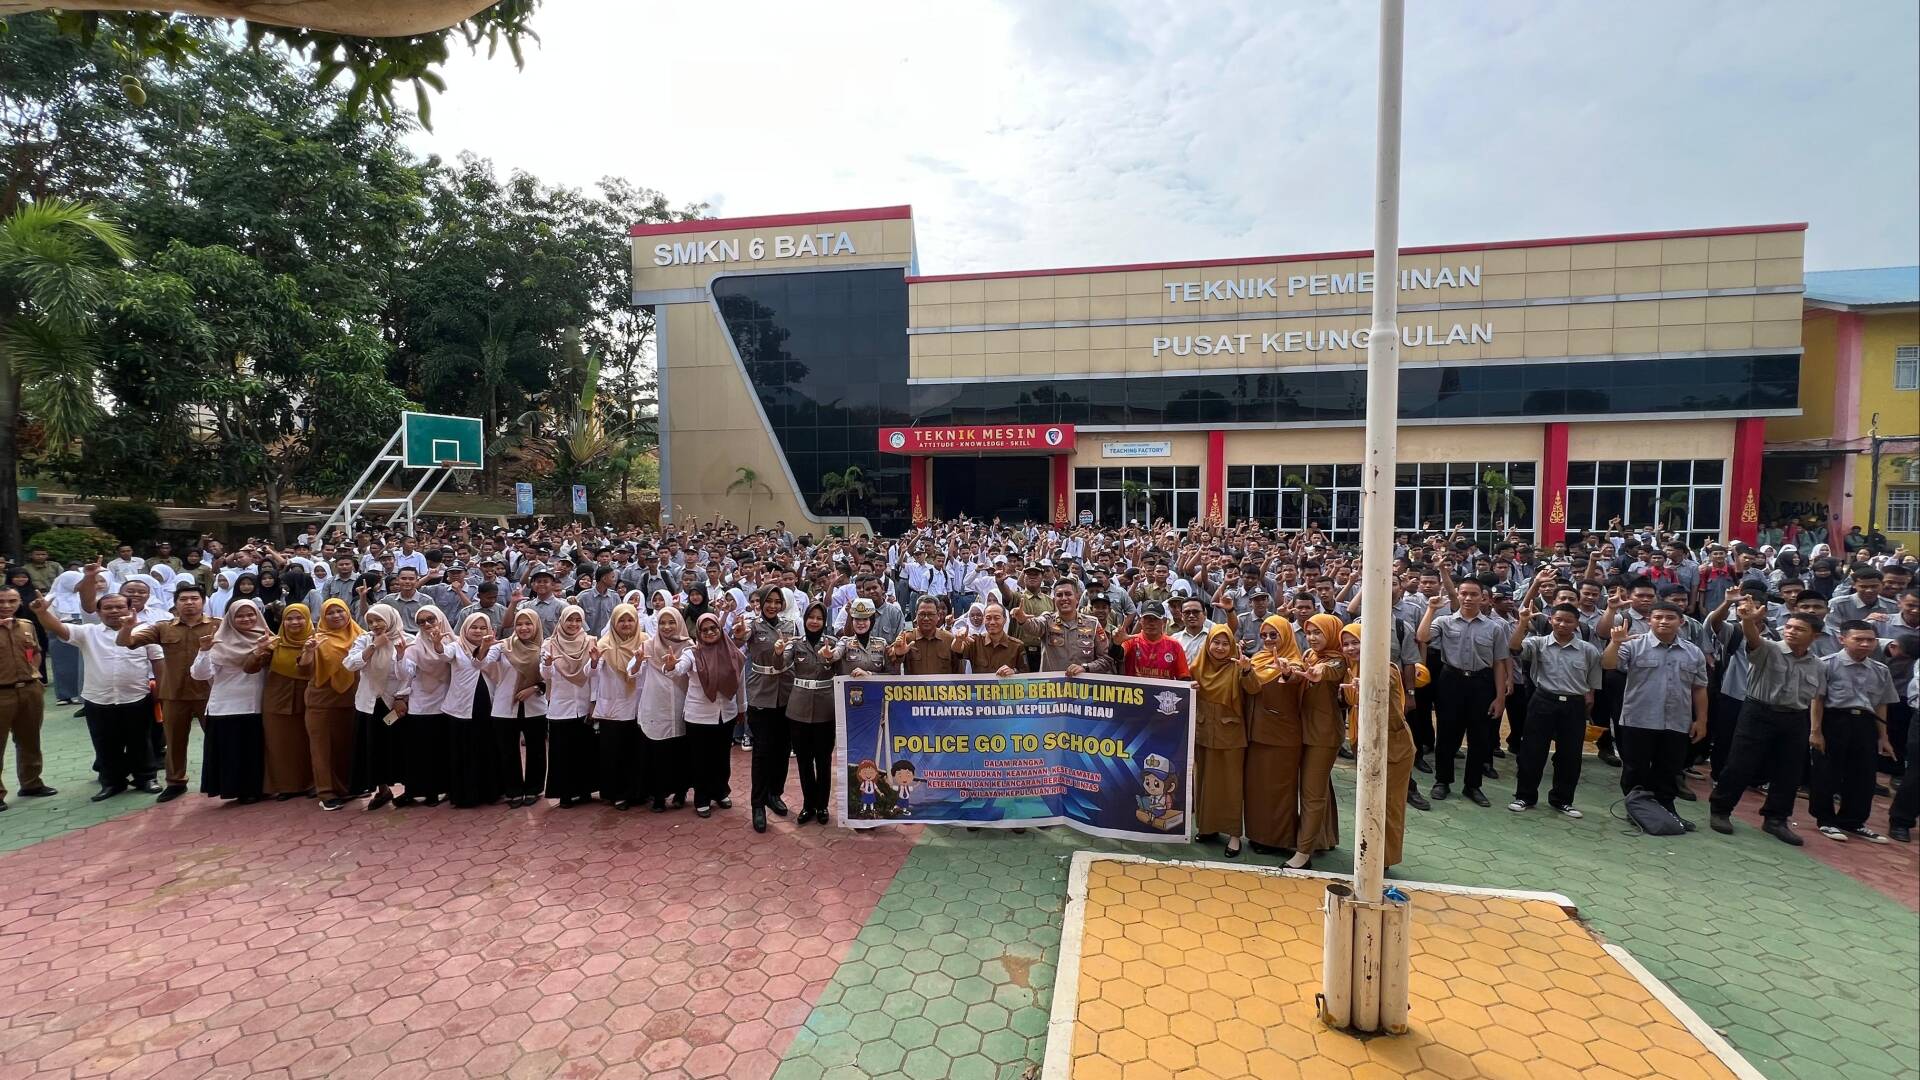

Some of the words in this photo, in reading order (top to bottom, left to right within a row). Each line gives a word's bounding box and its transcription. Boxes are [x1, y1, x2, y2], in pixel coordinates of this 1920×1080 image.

[653, 238, 740, 266] SMKN
[750, 237, 765, 260] 6
[775, 231, 856, 258] BATA
[1165, 277, 1278, 302] TEKNIK
[1288, 265, 1481, 297] PEMEINAN
[1152, 334, 1252, 357] PUSAT
[1262, 322, 1493, 354] KEUNGULAN
[914, 430, 976, 441] TEKNIK
[983, 428, 1036, 439] MESIN
[884, 685, 972, 702] SOSIALISASI
[975, 684, 1025, 701] TERTIB
[1028, 682, 1089, 700] BERLALU
[1092, 684, 1144, 705] LINTAS
[911, 705, 974, 717] DITLANTAS
[976, 705, 1014, 716] POLDA
[1016, 704, 1082, 716] KEPULAUAN
[1084, 705, 1114, 718] RIAU
[893, 734, 970, 754] POLICE
[974, 733, 1007, 753] GO
[1010, 732, 1038, 752] TO
[1043, 731, 1130, 759] SCHOOL
[983, 759, 1011, 768] DALAM
[1012, 758, 1045, 767] RANGKA
[923, 770, 948, 779] UNTUK
[949, 769, 1003, 779] MEWUJUDKAN
[927, 779, 973, 789] KETERTIBAN
[974, 780, 991, 788] DAN
[991, 778, 1041, 788] KELANCARAN
[1073, 780, 1099, 793] LINTAS
[960, 790, 969, 798] DI
[969, 788, 1004, 798] WILAYAH
[1004, 788, 1049, 798] KEPULAUAN
